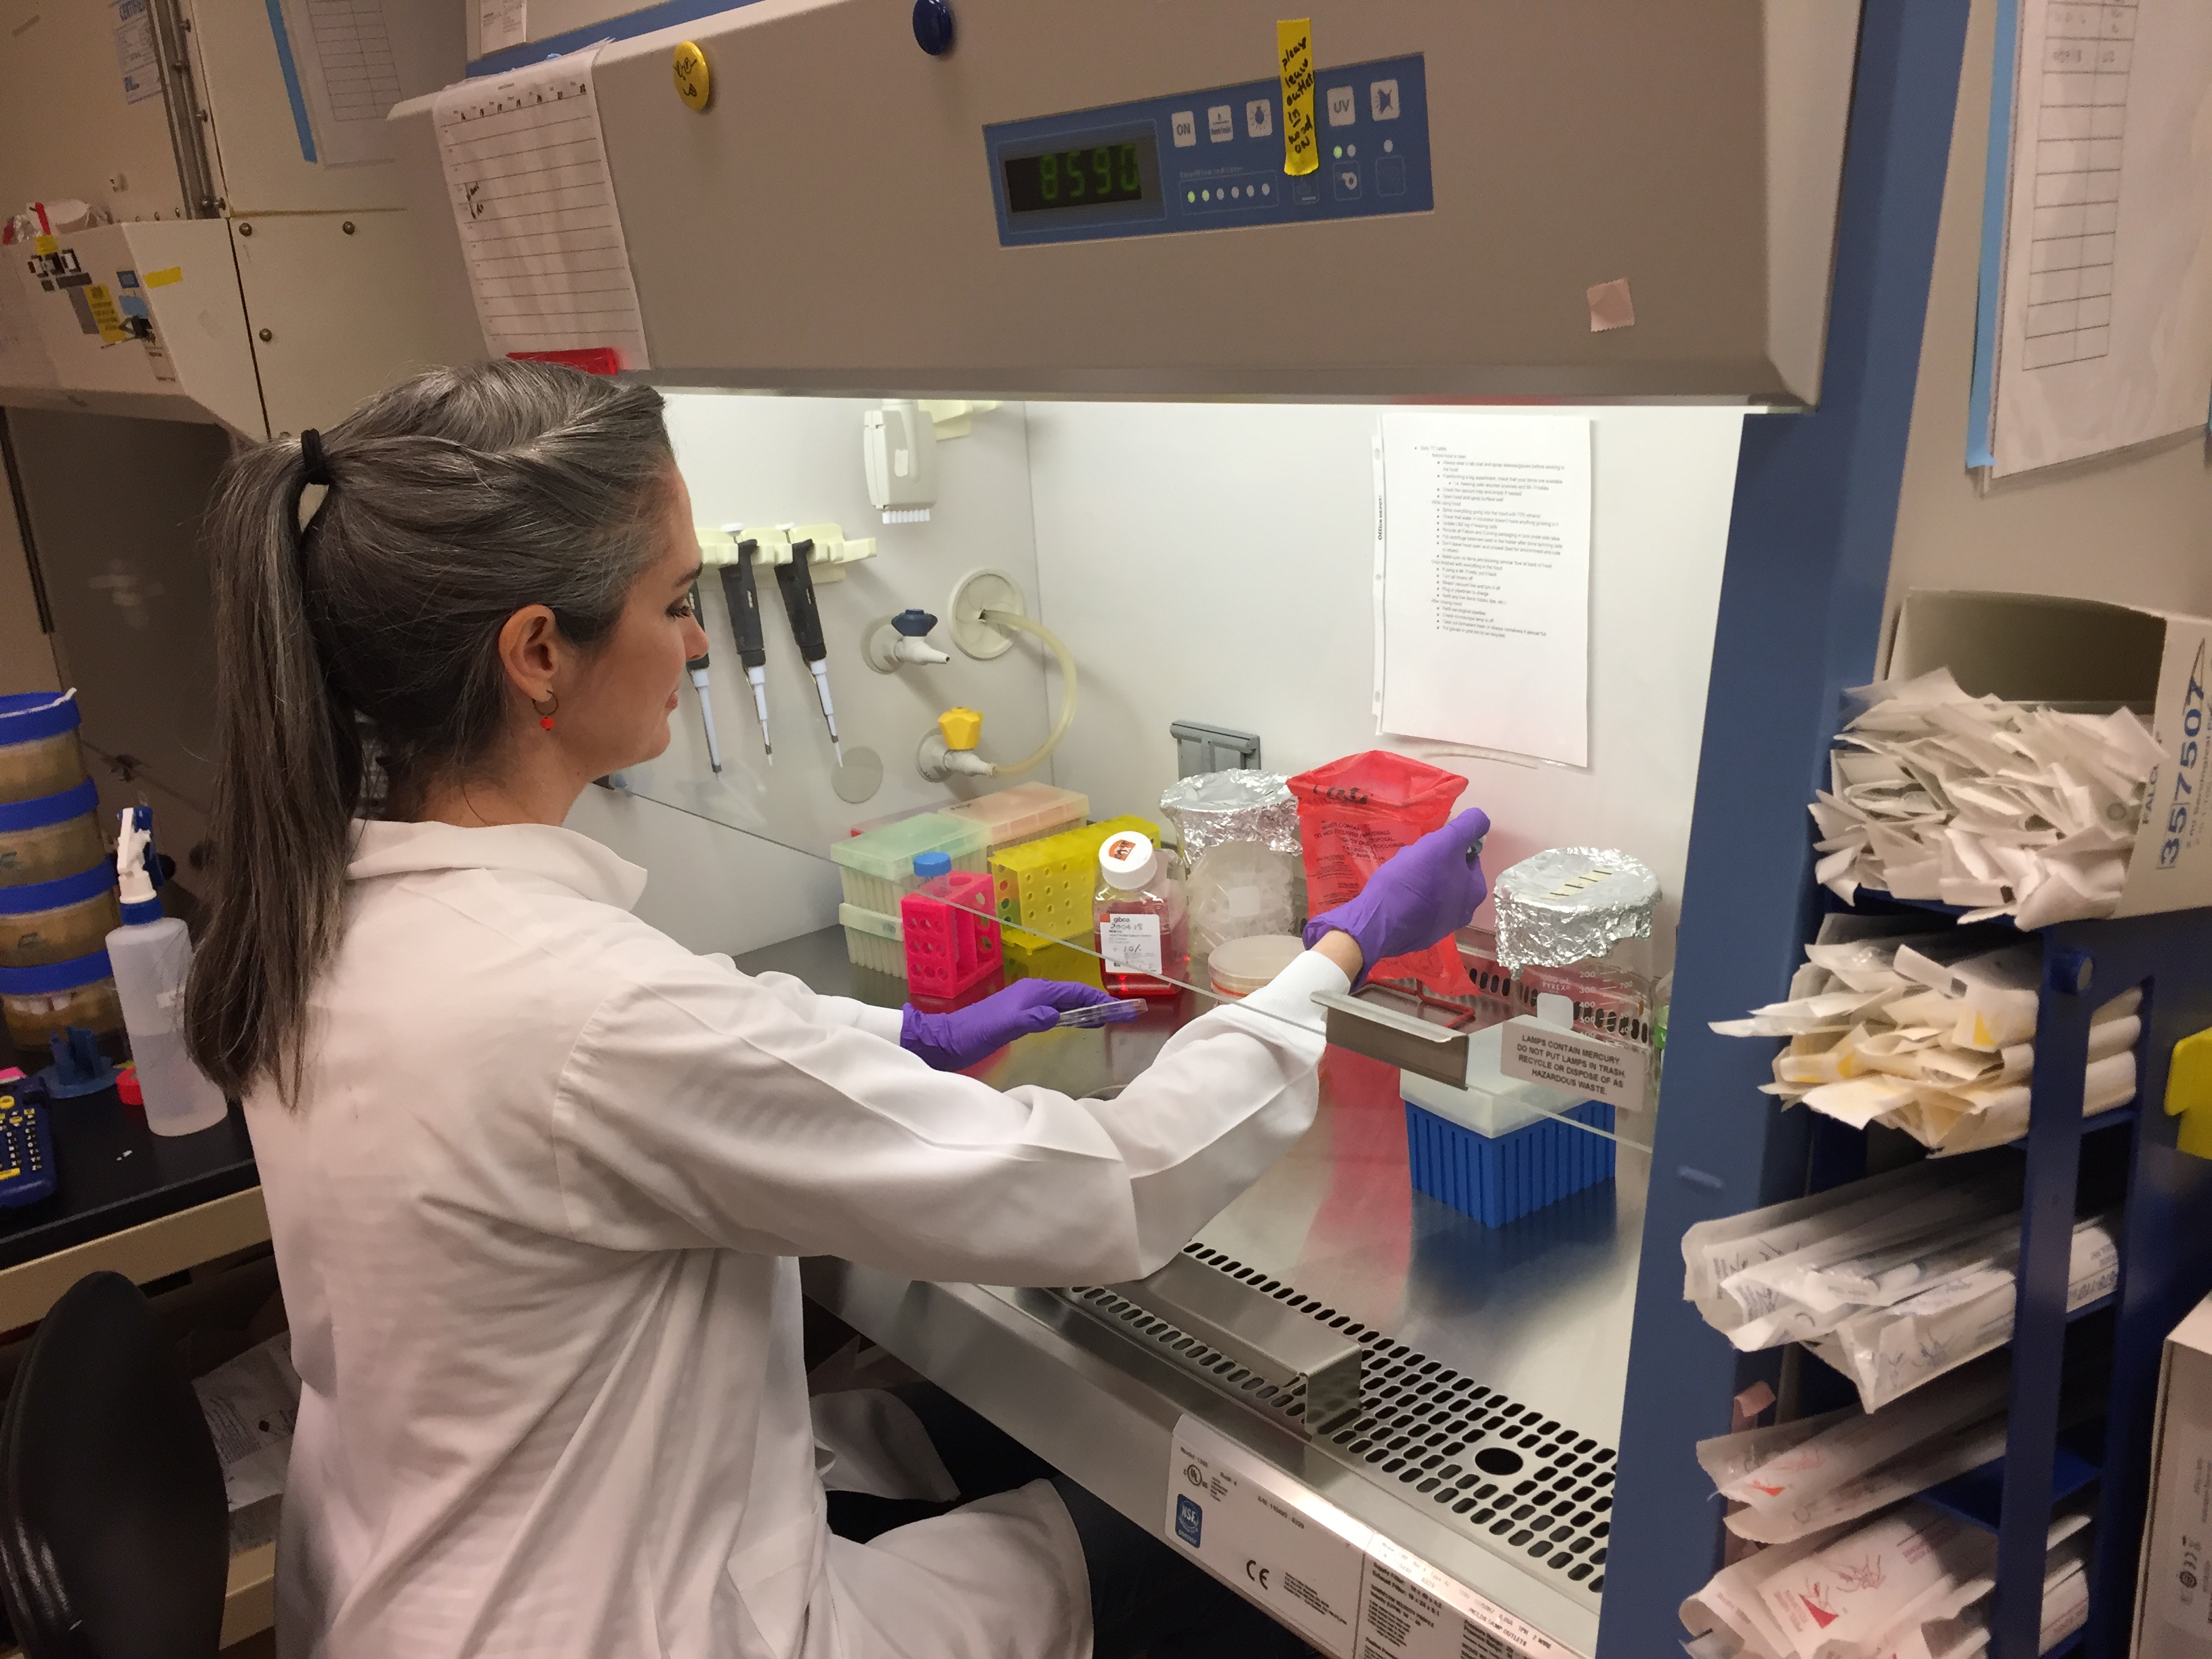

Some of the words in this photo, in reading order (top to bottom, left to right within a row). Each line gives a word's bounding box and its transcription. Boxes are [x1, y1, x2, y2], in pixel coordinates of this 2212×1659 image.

[1286, 73, 1313, 106] outlet
[1334, 100, 1349, 114] UV
[1176, 123, 1191, 136] ON
[1620, 981, 1633, 989] 700
[1522, 1034, 1547, 1046] LAMPS
[1548, 1040, 1580, 1055] CONTAIN
[1517, 1044, 1528, 1052] DO
[1529, 1046, 1544, 1057] NOT
[1546, 1049, 1561, 1060] PUT
[1562, 1054, 1586, 1068] LAMPS
[1589, 1061, 1597, 1070] IN
[1518, 1054, 1552, 1069] RECYCLE
[1553, 1063, 1564, 1073] OR
[1566, 1067, 1598, 1082] DISPOSE
[1601, 1075, 1611, 1084] OF
[1613, 1079, 1624, 1088] AS
[1532, 1069, 1576, 1086] HAZARDOUS
[1182, 1504, 1196, 1522] NSF
[1246, 1559, 1269, 1590] CE
